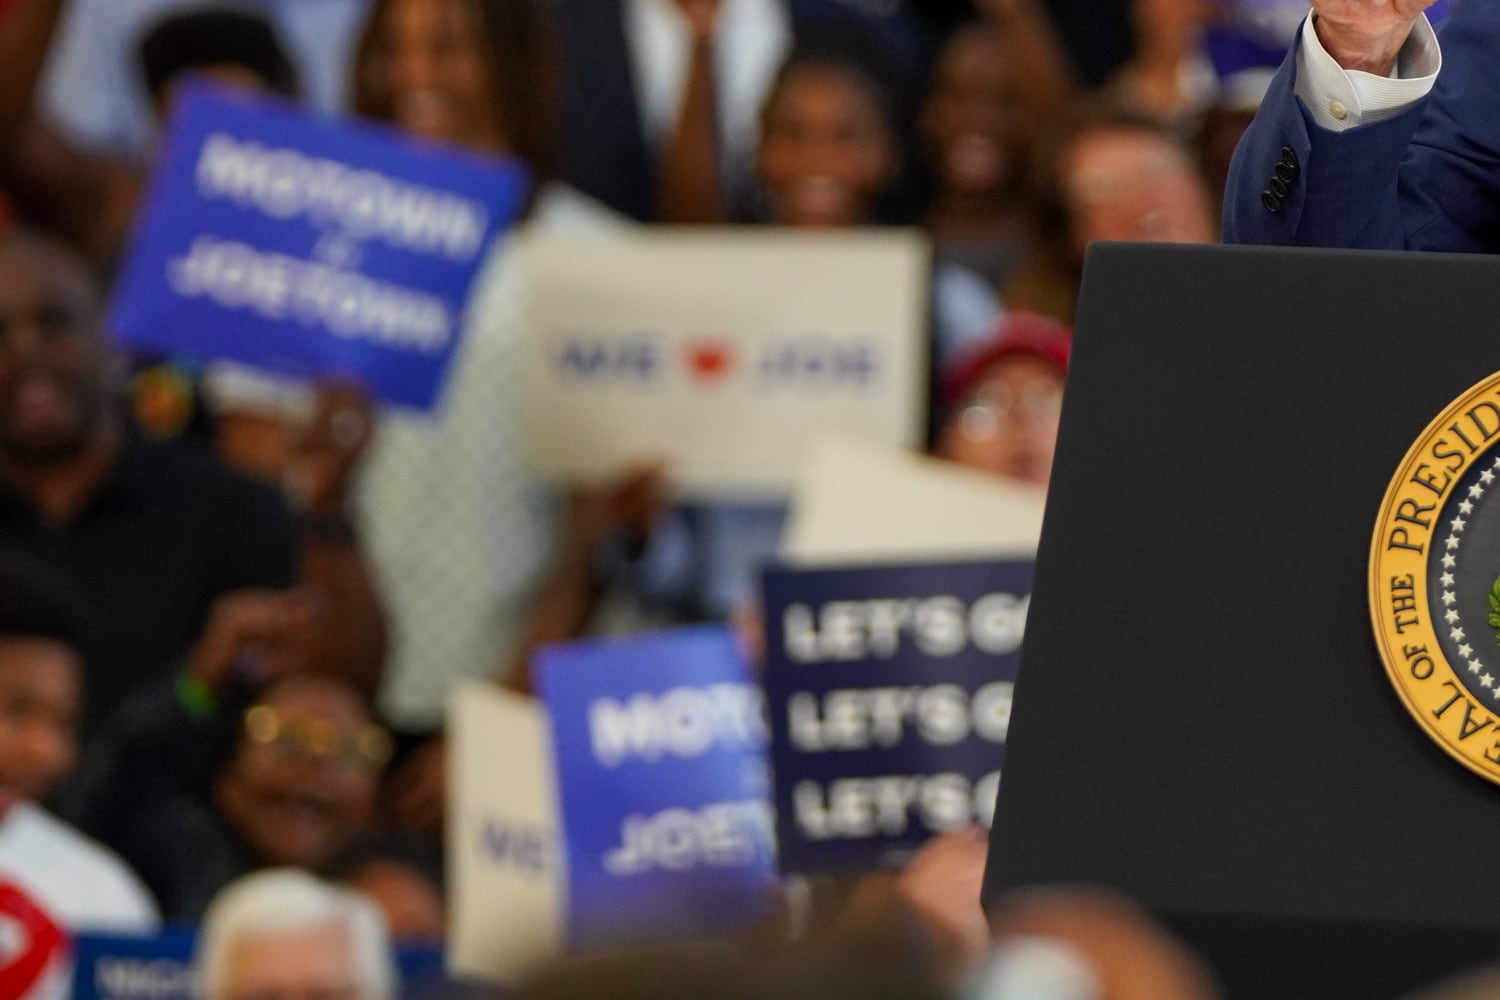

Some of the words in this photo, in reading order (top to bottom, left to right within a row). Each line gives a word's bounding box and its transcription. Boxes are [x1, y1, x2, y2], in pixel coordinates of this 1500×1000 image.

[196, 134, 488, 260] MOTOWN
[167, 236, 450, 352] JOETOWN
[553, 335, 660, 385] WE
[757, 335, 880, 385] JOE
[783, 597, 967, 663] LET'S
[1389, 572, 1420, 635] THE
[1403, 642, 1436, 681] OF
[788, 685, 970, 752] LET'S
[793, 773, 972, 842] LET'S
